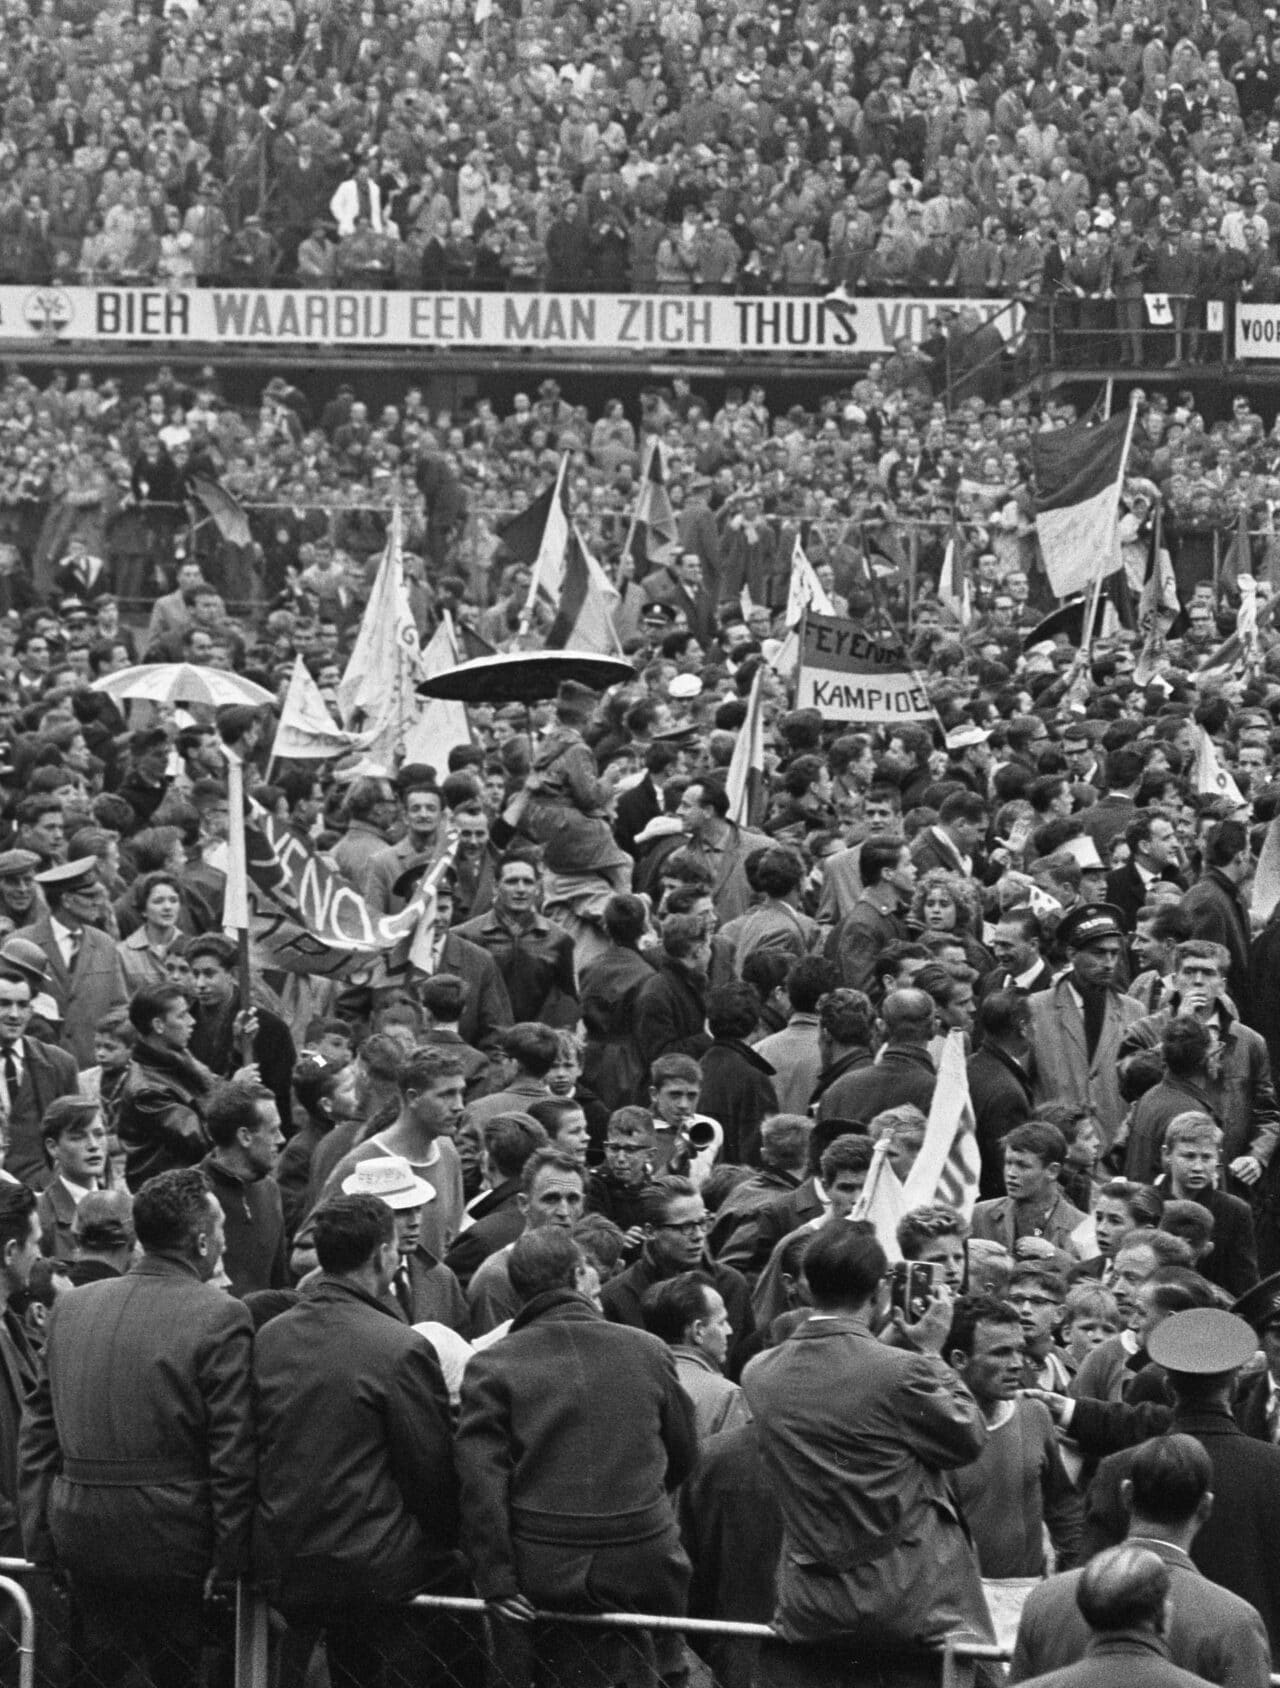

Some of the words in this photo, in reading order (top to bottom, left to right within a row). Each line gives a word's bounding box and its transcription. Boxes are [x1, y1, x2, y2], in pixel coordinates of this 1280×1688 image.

[96, 292, 189, 334] BIER
[212, 293, 388, 338] WAARBIJ
[409, 296, 482, 339] EEN
[504, 298, 596, 341] MAN
[617, 299, 711, 343] ZICH
[733, 301, 858, 345] THUIS
